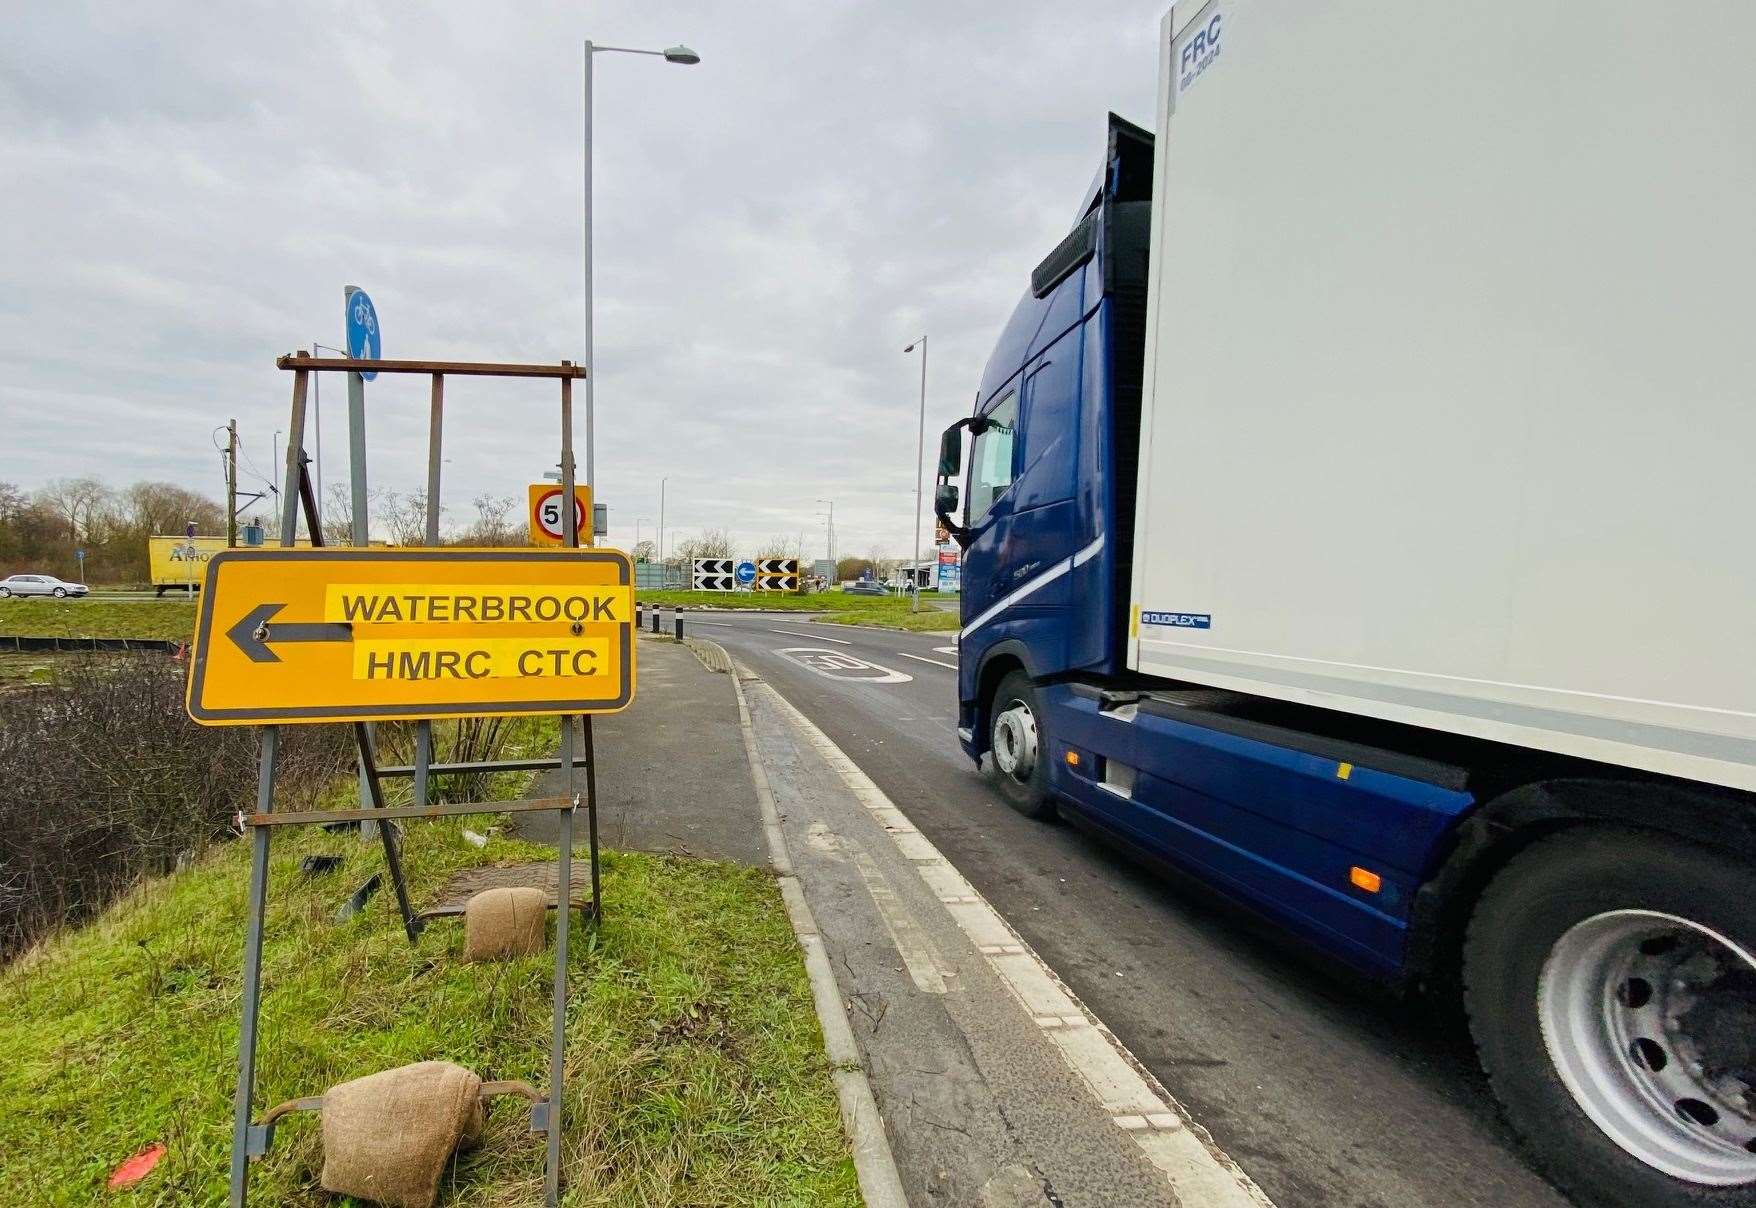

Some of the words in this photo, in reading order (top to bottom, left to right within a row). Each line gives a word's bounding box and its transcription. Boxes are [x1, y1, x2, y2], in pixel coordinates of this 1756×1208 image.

[1181, 14, 1221, 74] FRC
[341, 595, 617, 622] WATERBROOK
[1151, 613, 1195, 626] DUOPLEX
[367, 650, 492, 680] HMRC
[517, 649, 599, 677] CTC
